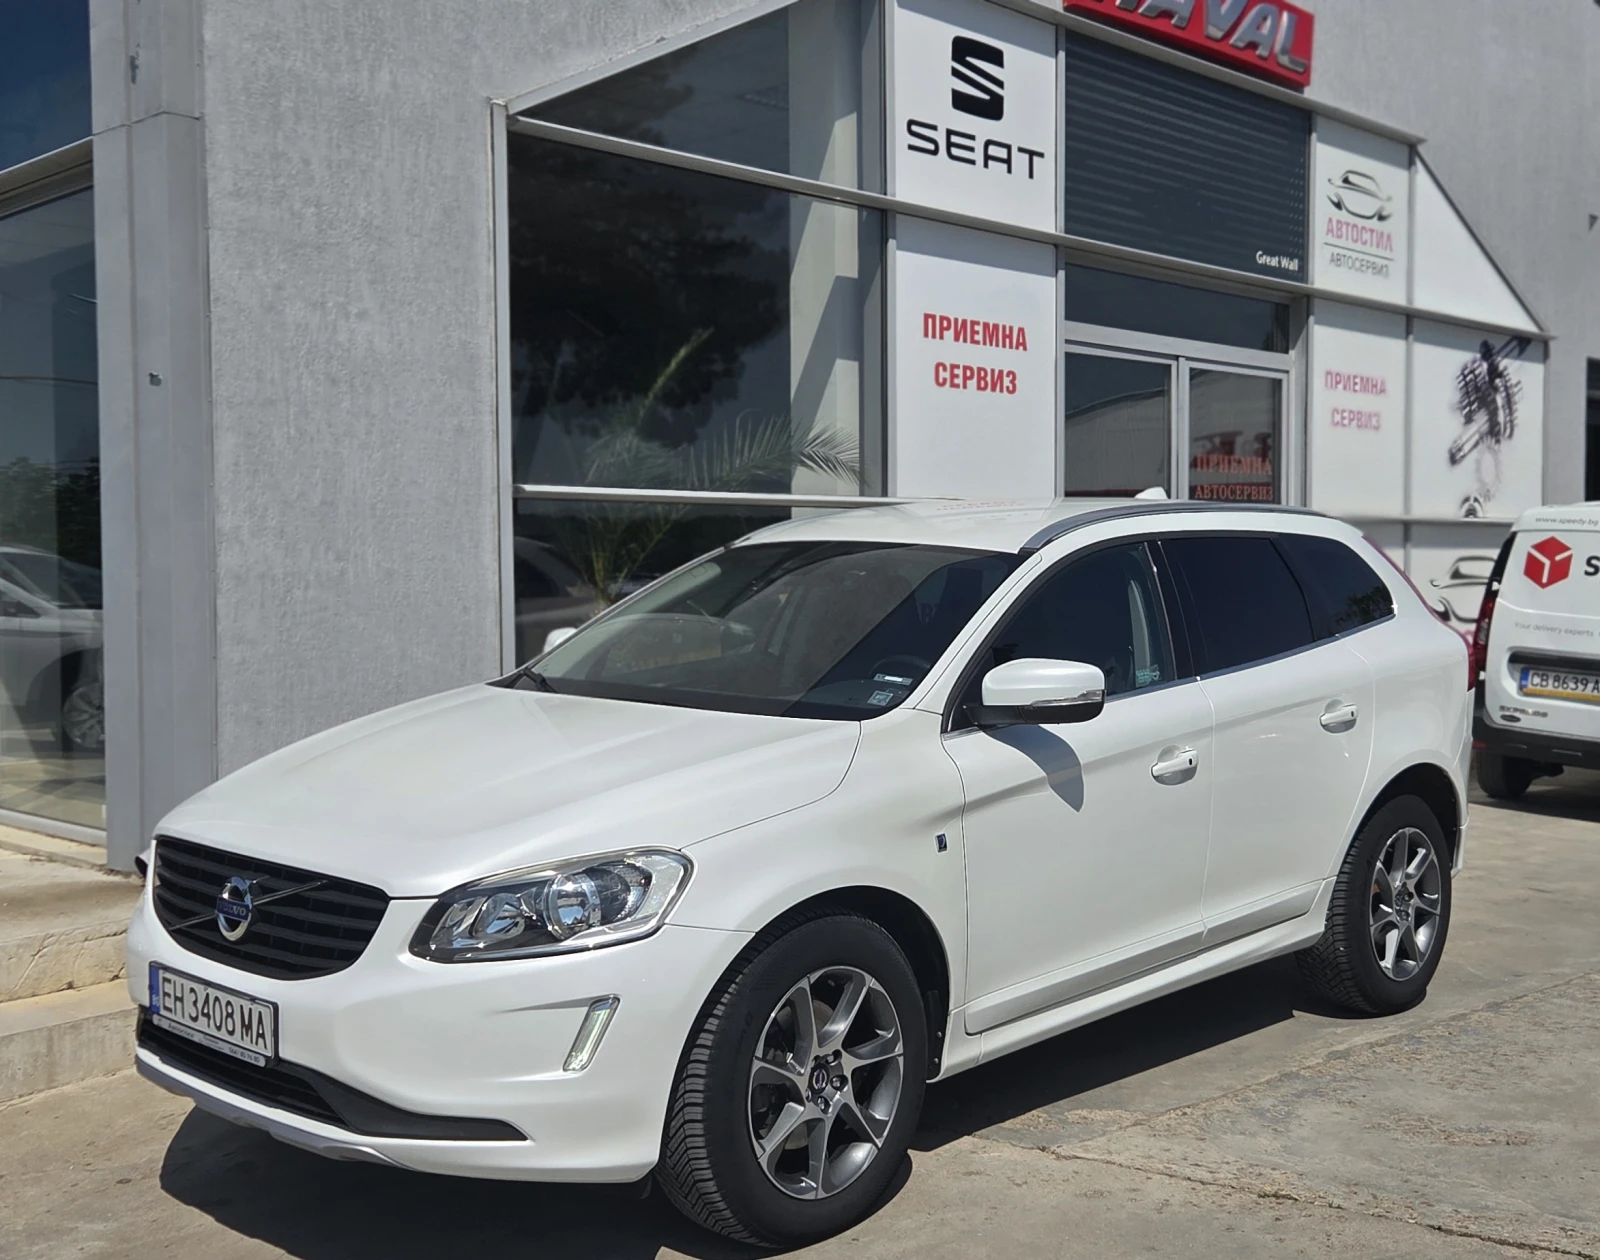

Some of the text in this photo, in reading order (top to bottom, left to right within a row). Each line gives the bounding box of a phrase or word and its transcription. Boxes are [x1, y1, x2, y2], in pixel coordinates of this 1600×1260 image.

[1095, 0, 1309, 73] AVAL
[906, 118, 1045, 180] SEAT
[1325, 217, 1393, 252] АВТОСТИЛ
[1255, 250, 1299, 271] Great Wall
[1329, 252, 1390, 278] АВТОСЕРВИЗ
[923, 312, 1028, 352] ПРИЕМНА
[934, 361, 1018, 395] СЕРВИЗ
[1324, 369, 1387, 397] ПРИЕМНА
[1331, 407, 1382, 432] СЕРВИЗ
[1196, 454, 1273, 476] ПРИЕМНА
[1194, 484, 1274, 500] АВТОСЕРВИЗ
[1535, 516, 1599, 527] www.speedy.bg
[1551, 674, 1589, 692] 8639
[217, 899, 248, 917] OLVO
